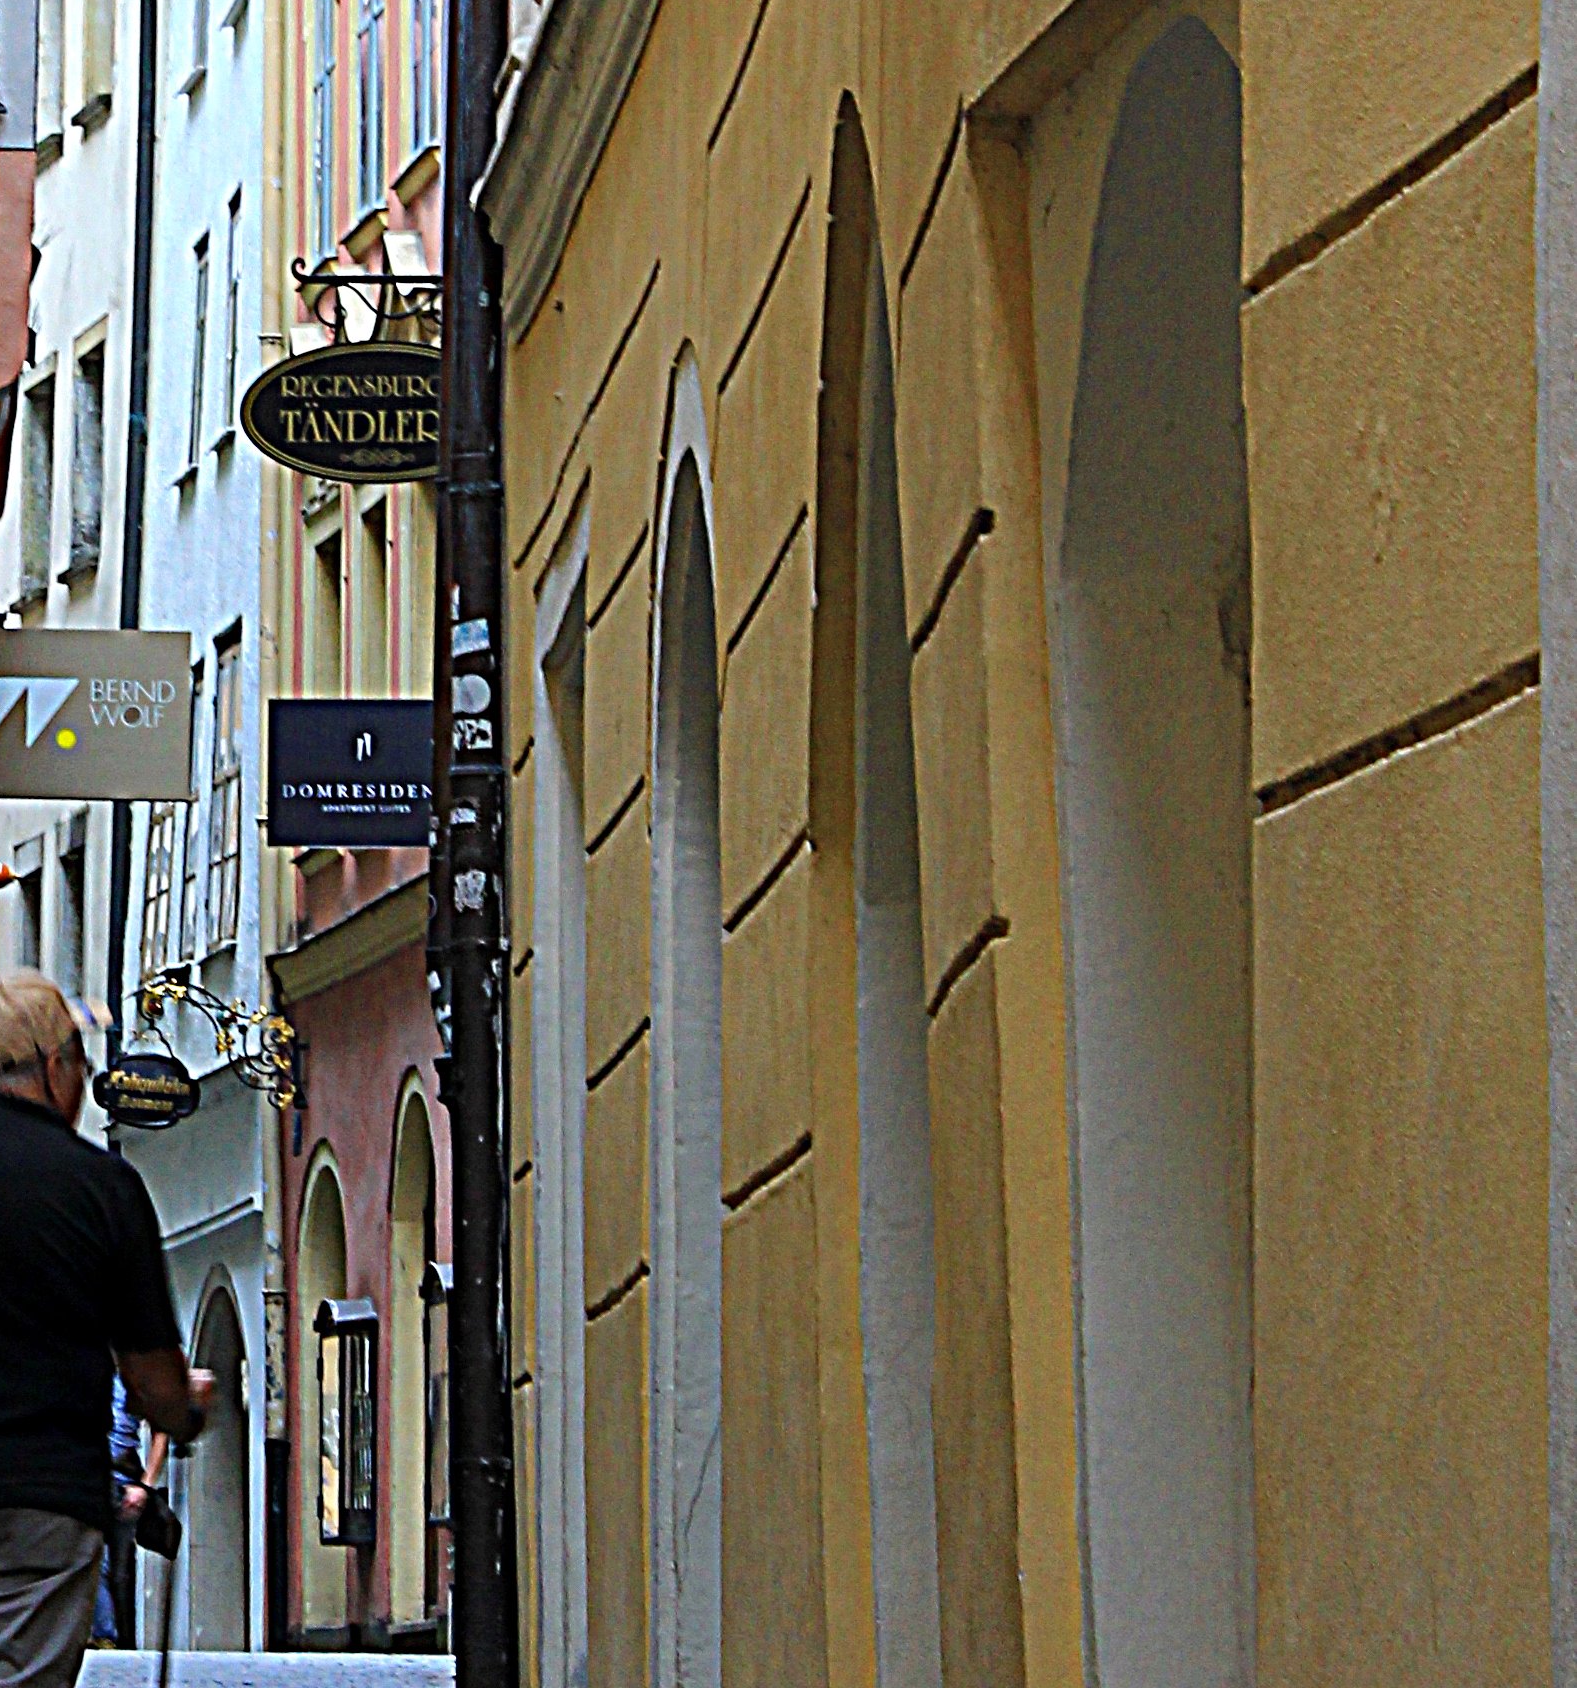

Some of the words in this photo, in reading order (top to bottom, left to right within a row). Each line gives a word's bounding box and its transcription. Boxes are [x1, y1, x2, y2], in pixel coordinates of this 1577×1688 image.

[279, 402, 440, 443] TÄNDLER
[89, 678, 177, 704] BERND
[88, 703, 165, 728] WOLF
